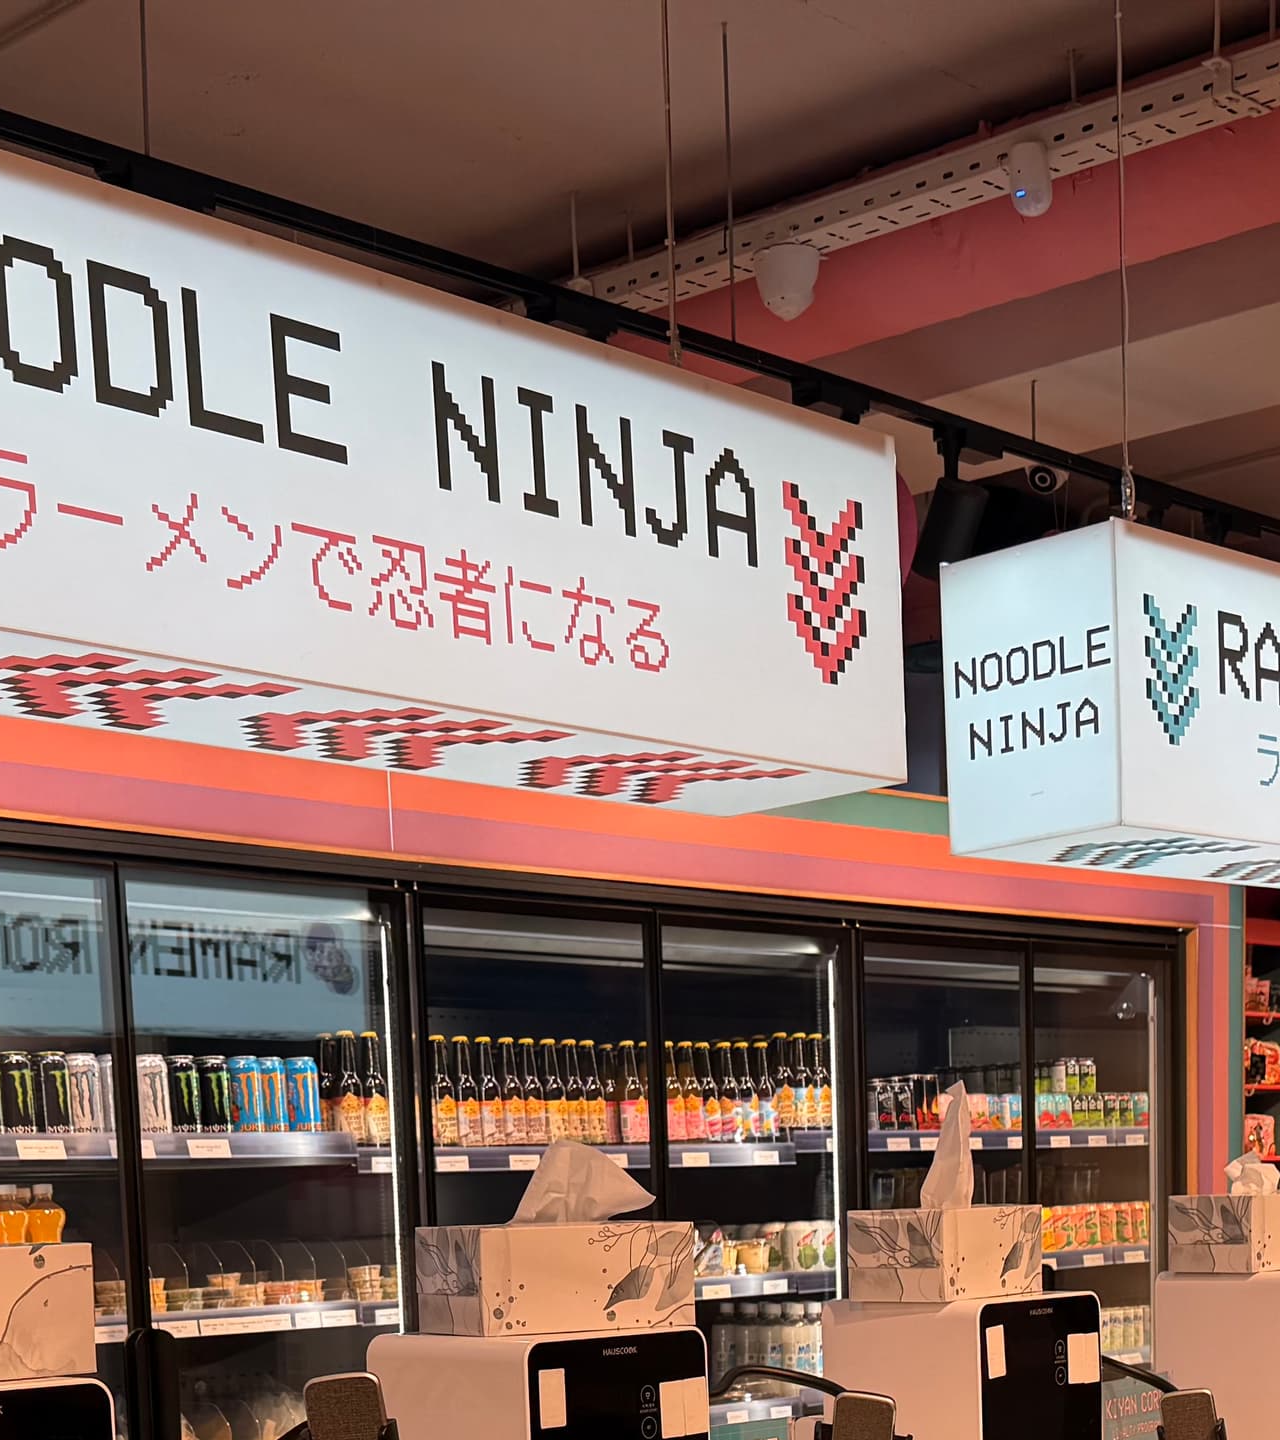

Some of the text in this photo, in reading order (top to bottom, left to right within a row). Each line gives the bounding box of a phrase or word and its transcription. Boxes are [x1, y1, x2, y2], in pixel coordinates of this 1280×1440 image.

[431, 360, 758, 568] NINJA
[954, 625, 1111, 699] NOODLE
[968, 697, 1100, 761] NINJA
